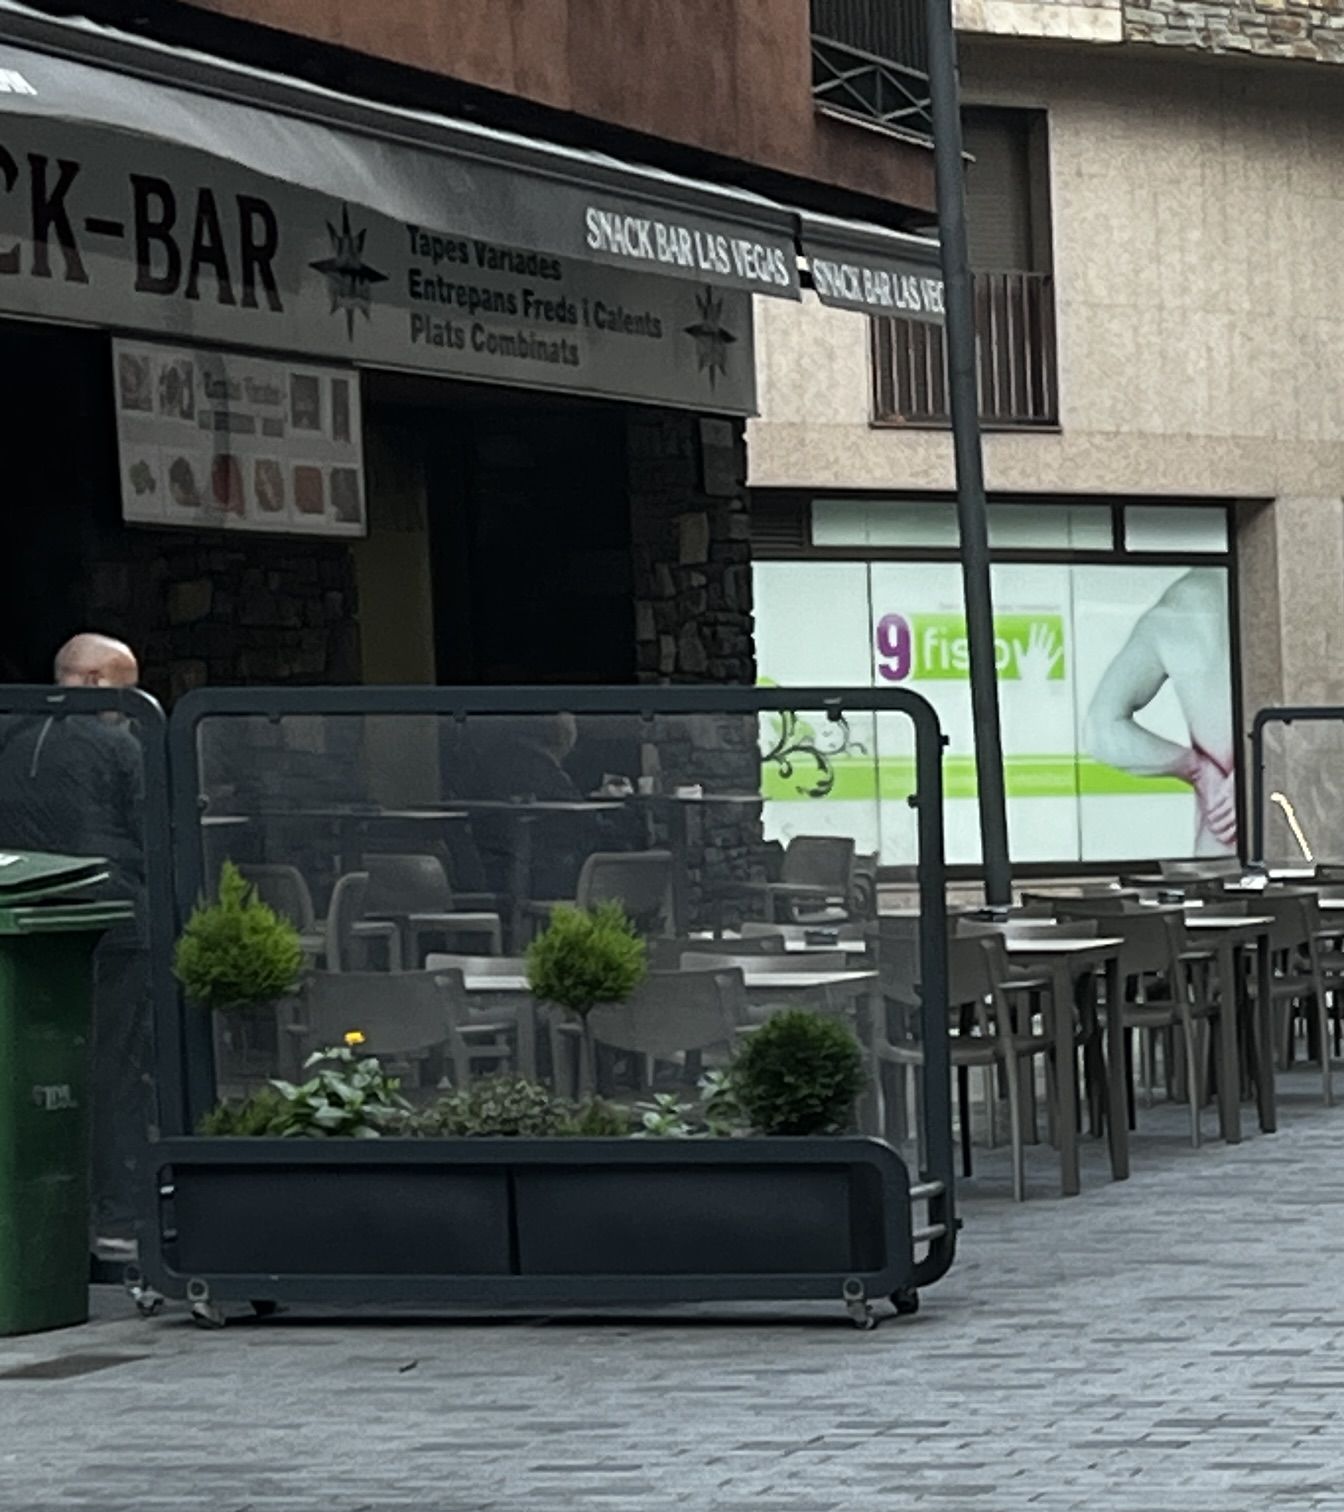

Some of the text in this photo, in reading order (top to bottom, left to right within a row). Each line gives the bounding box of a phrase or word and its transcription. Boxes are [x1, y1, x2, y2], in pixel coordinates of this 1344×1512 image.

[406, 223, 469, 265] Tapes
[586, 207, 789, 286] SNACK BAR LAS VEGAS
[407, 268, 518, 315] Entrepans
[523, 289, 578, 325] Freds
[593, 301, 663, 338] Calents
[813, 258, 863, 302] SNACK
[863, 268, 894, 306] BAR
[893, 273, 921, 311] LAS
[409, 313, 580, 366] Plats Combinats
[877, 613, 911, 681] 9
